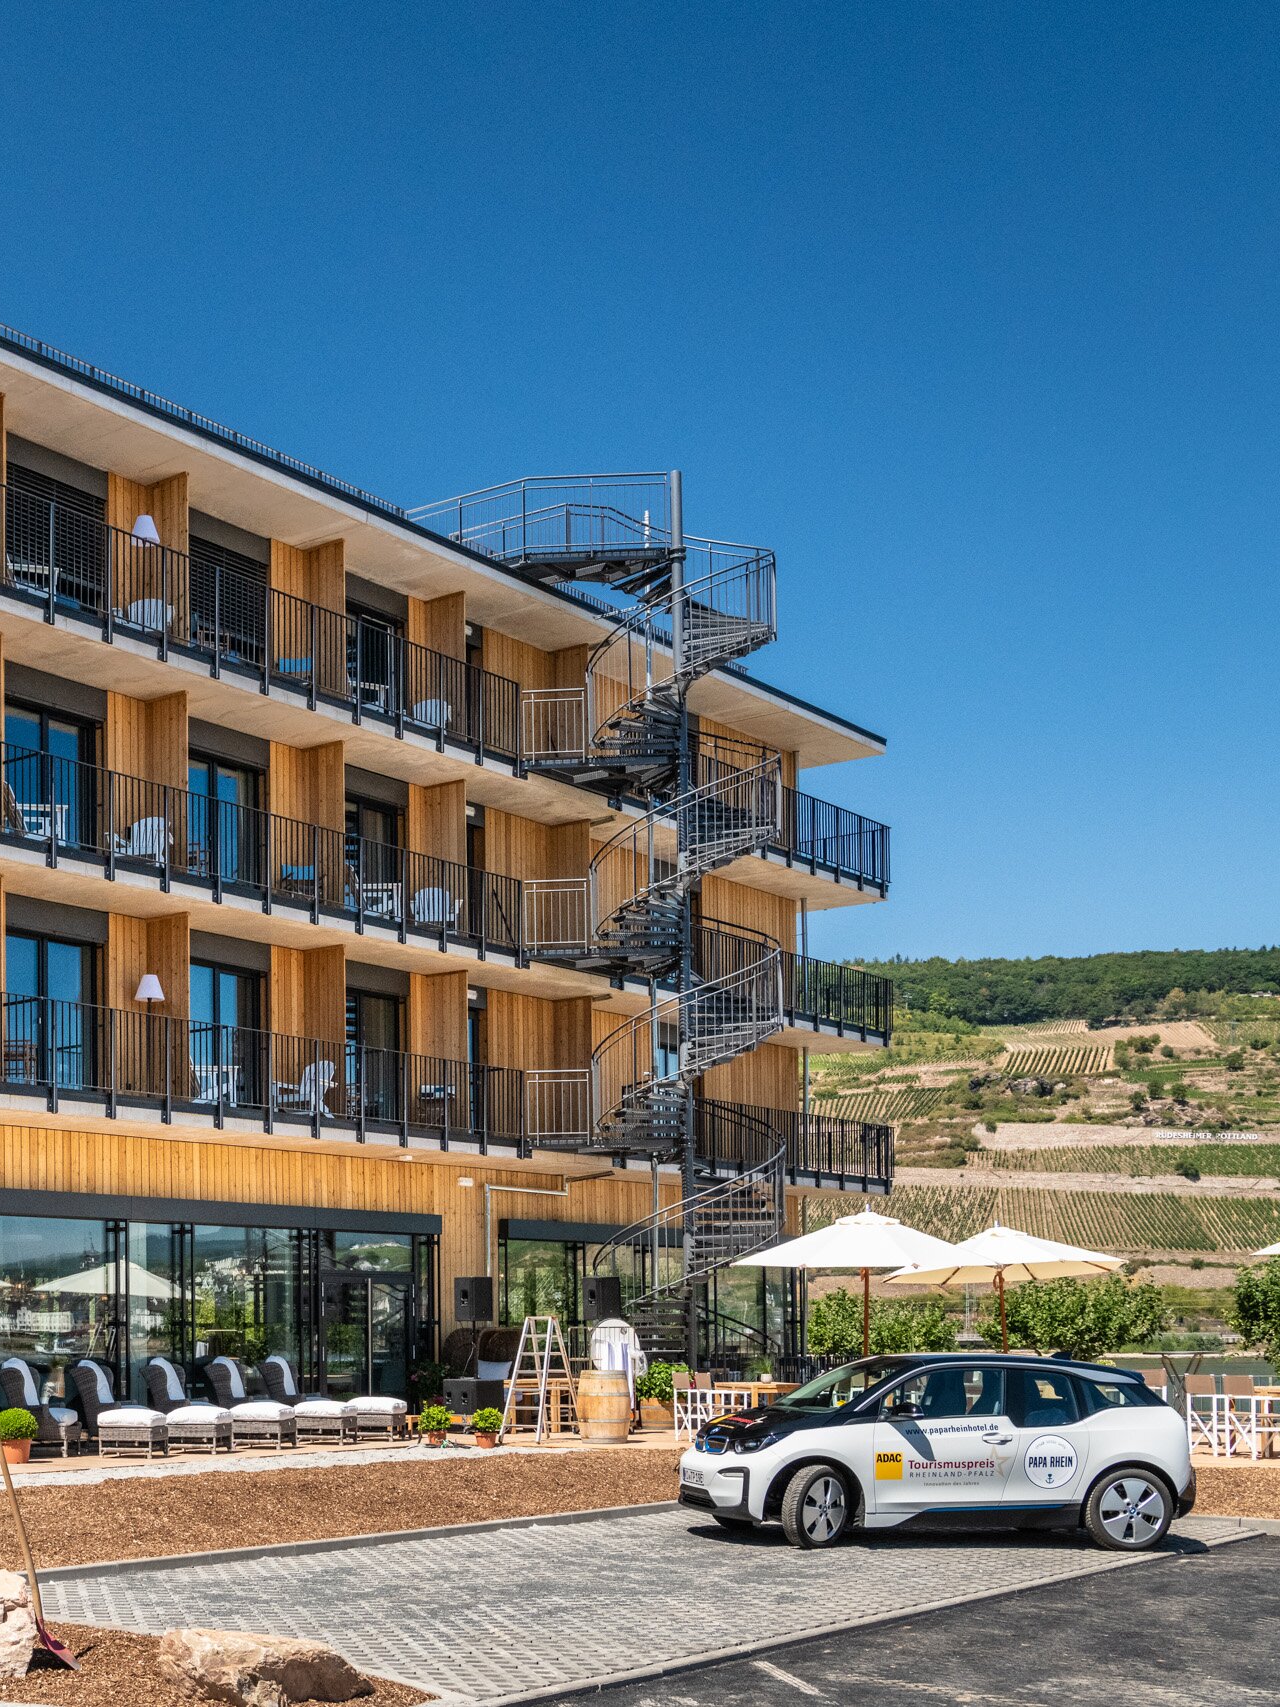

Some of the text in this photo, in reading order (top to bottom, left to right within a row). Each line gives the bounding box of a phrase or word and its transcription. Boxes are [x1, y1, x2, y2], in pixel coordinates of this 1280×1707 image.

[905, 1423, 999, 1436] www.paparheinhotel.de
[876, 1453, 902, 1463] ADAC
[1028, 1456, 1073, 1468] PAPA RHEIN
[908, 1459, 995, 1470] Tourismuspreis
[909, 1470, 995, 1478] RHEINLAND-PFALZ
